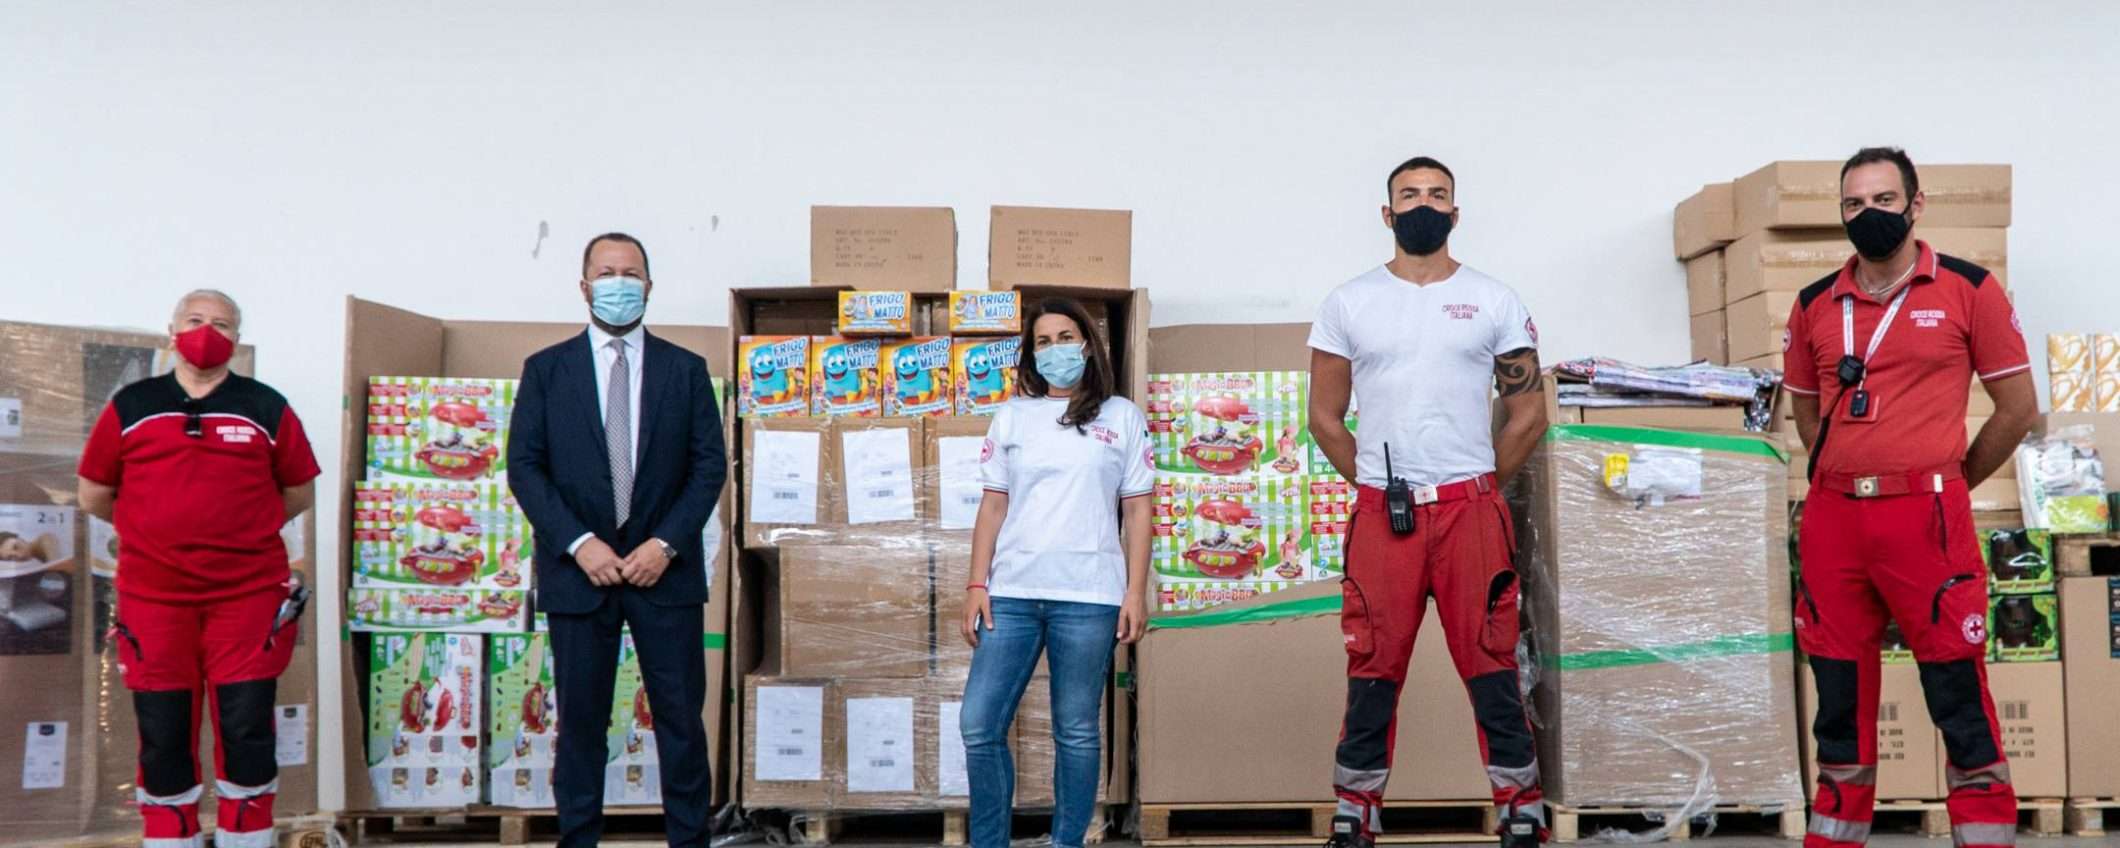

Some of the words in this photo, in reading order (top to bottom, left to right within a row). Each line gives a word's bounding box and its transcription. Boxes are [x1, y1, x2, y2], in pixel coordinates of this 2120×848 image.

[869, 293, 904, 305] FRIGO
[980, 292, 1014, 305] FRIGO
[873, 304, 905, 319] MATTO
[984, 303, 1014, 319] MATTO
[773, 338, 806, 355] FRIGO
[846, 338, 879, 355] FRIGO
[917, 337, 950, 355] FRIGO
[988, 337, 1020, 355] FRIGO
[776, 353, 804, 368] MATTO
[848, 353, 877, 368] MATTO
[919, 353, 948, 368] MATTO
[990, 352, 1020, 368] MATTO
[37, 511, 46, 524] 2
